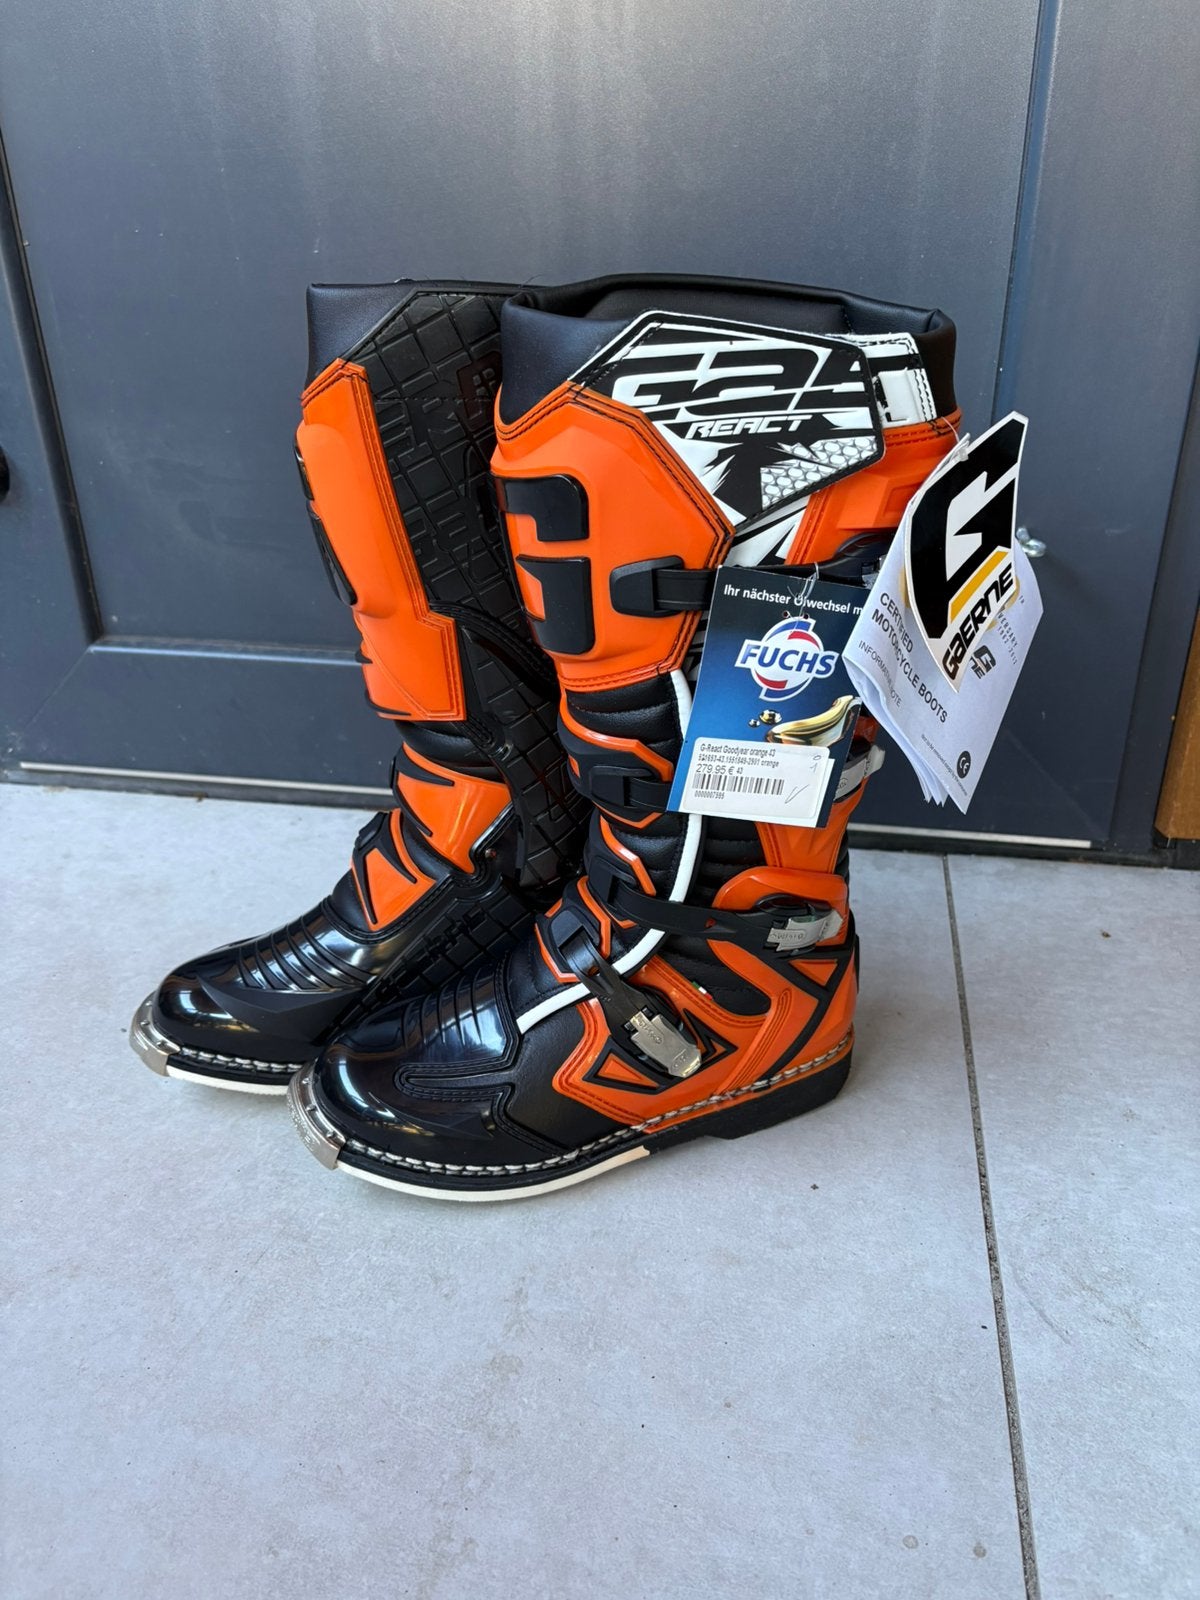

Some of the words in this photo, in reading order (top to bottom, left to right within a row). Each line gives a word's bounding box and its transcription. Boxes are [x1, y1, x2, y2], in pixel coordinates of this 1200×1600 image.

[685, 415, 812, 439] REACT
[723, 584, 740, 597] Ihr
[742, 588, 791, 605] nächster
[880, 592, 913, 653] CERTIFIED
[740, 643, 835, 676] FUCHS
[917, 682, 948, 723] BOOTS
[700, 743, 722, 753] G-React
[723, 745, 750, 756] Goodyear
[750, 748, 768, 759] orange
[768, 748, 776, 757] 43
[696, 763, 727, 775] 279.95
[728, 765, 736, 775] €
[760, 759, 779, 769] orange
